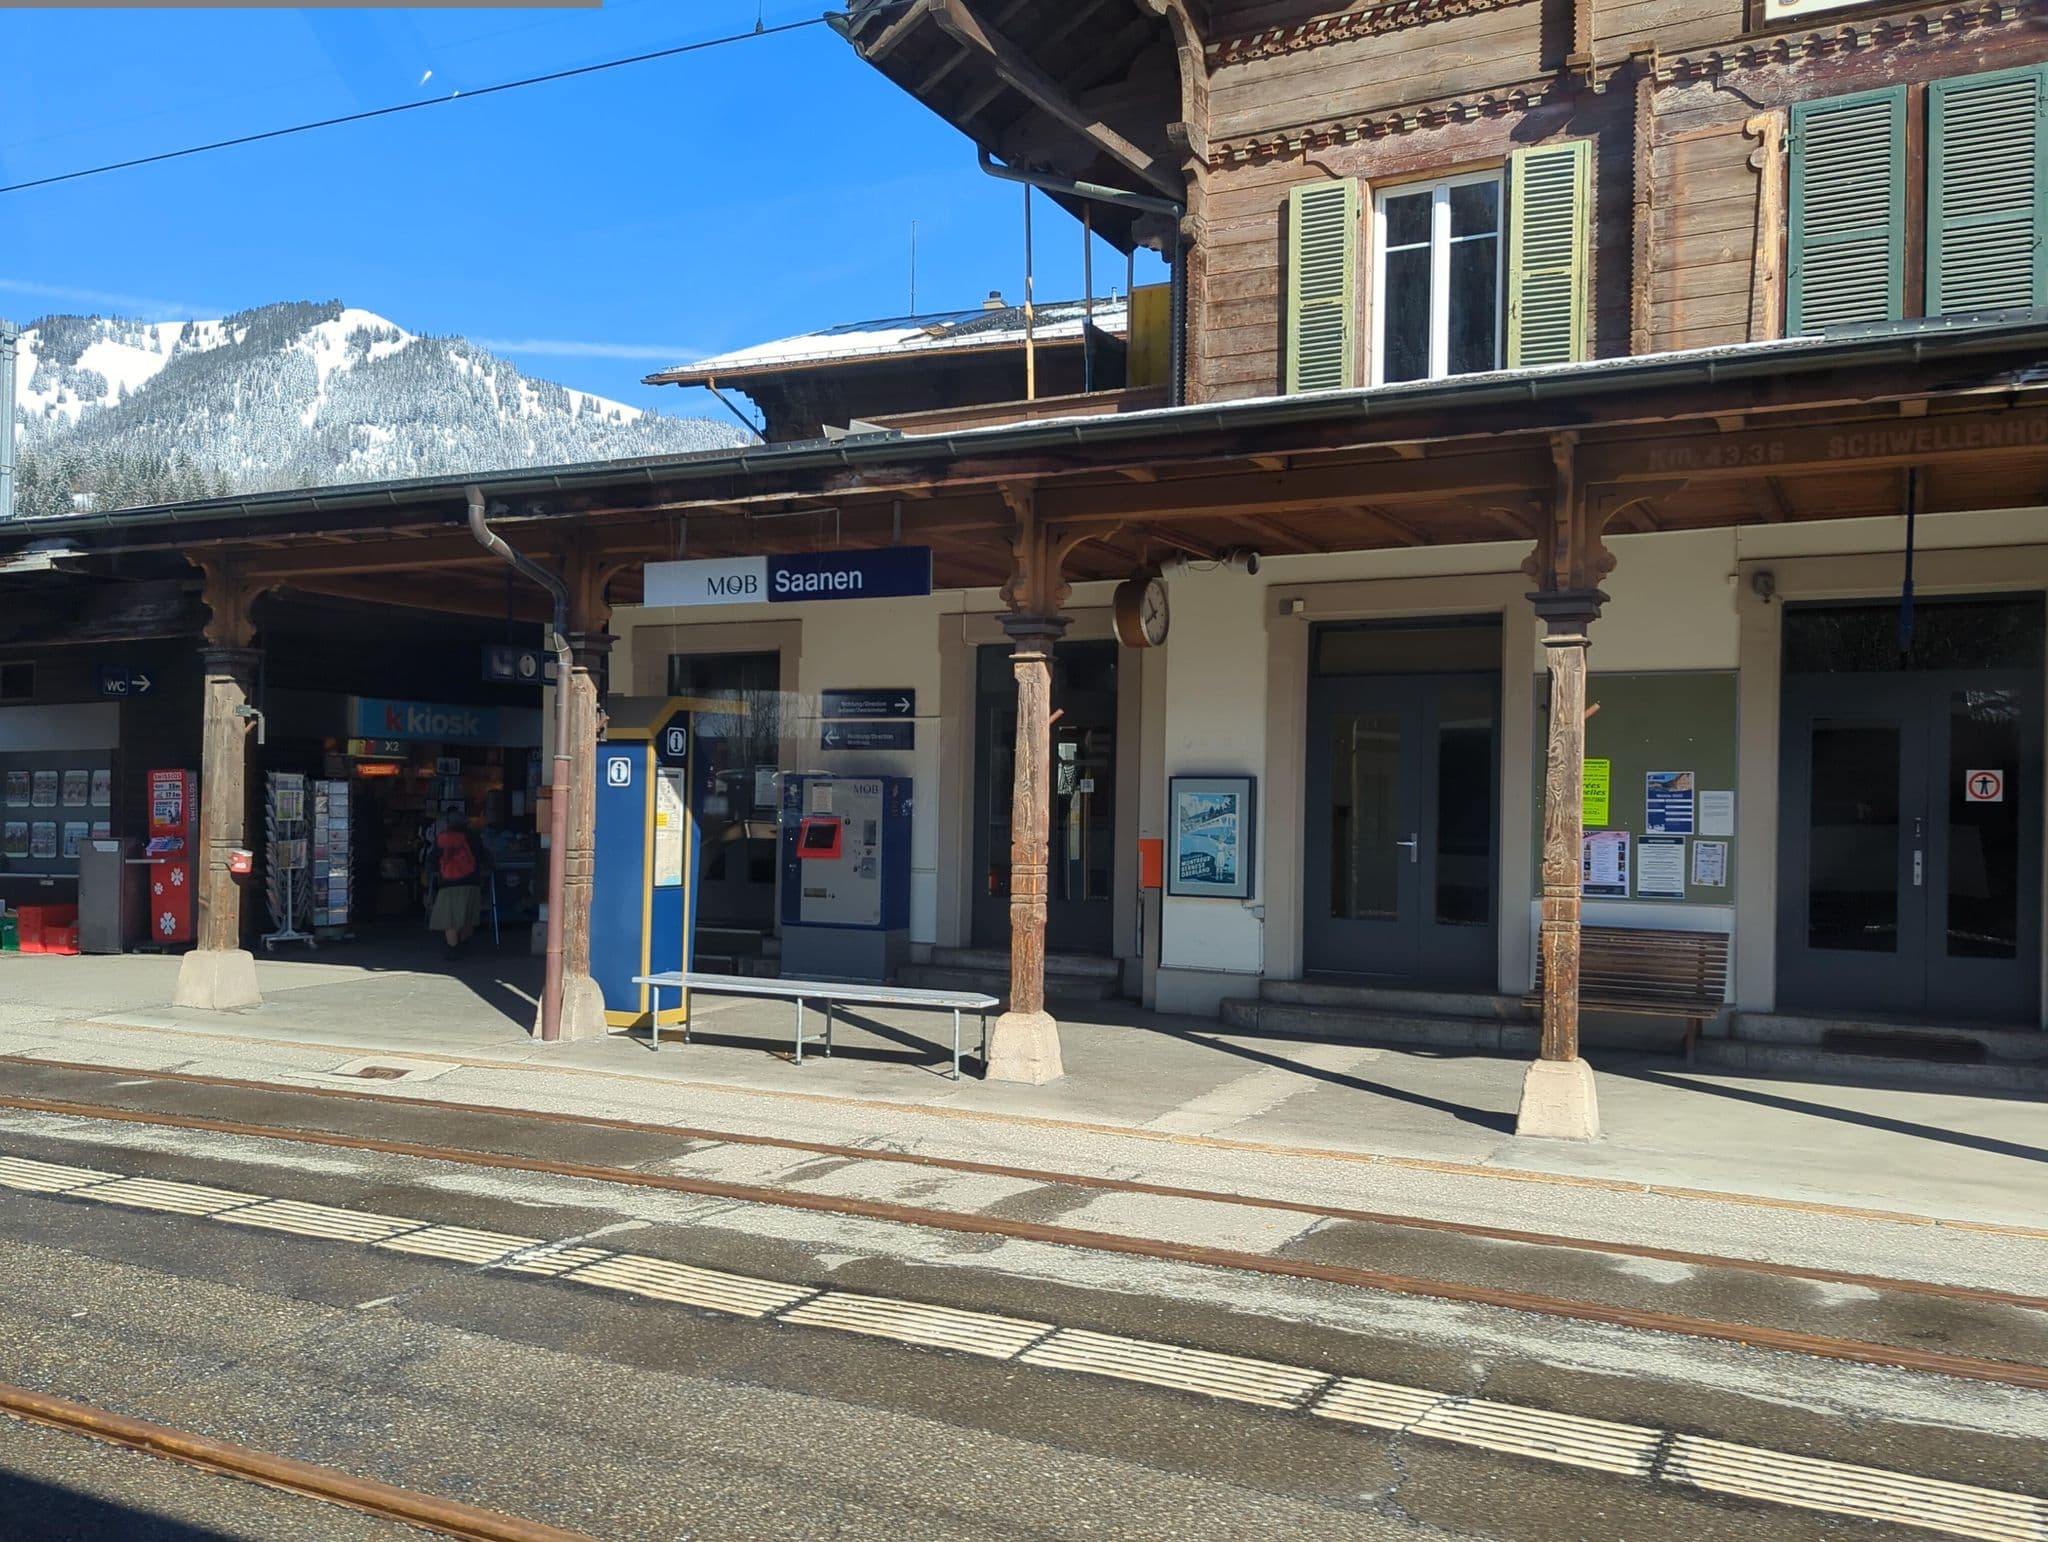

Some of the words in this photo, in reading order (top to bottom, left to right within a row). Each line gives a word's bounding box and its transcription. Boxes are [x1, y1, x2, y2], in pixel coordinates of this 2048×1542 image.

[707, 575, 758, 596] MOB
[775, 569, 863, 593] Saanen
[107, 680, 126, 692] WC
[384, 703, 402, 733] k
[407, 706, 480, 737] kiosk
[853, 783, 879, 795] MOB
